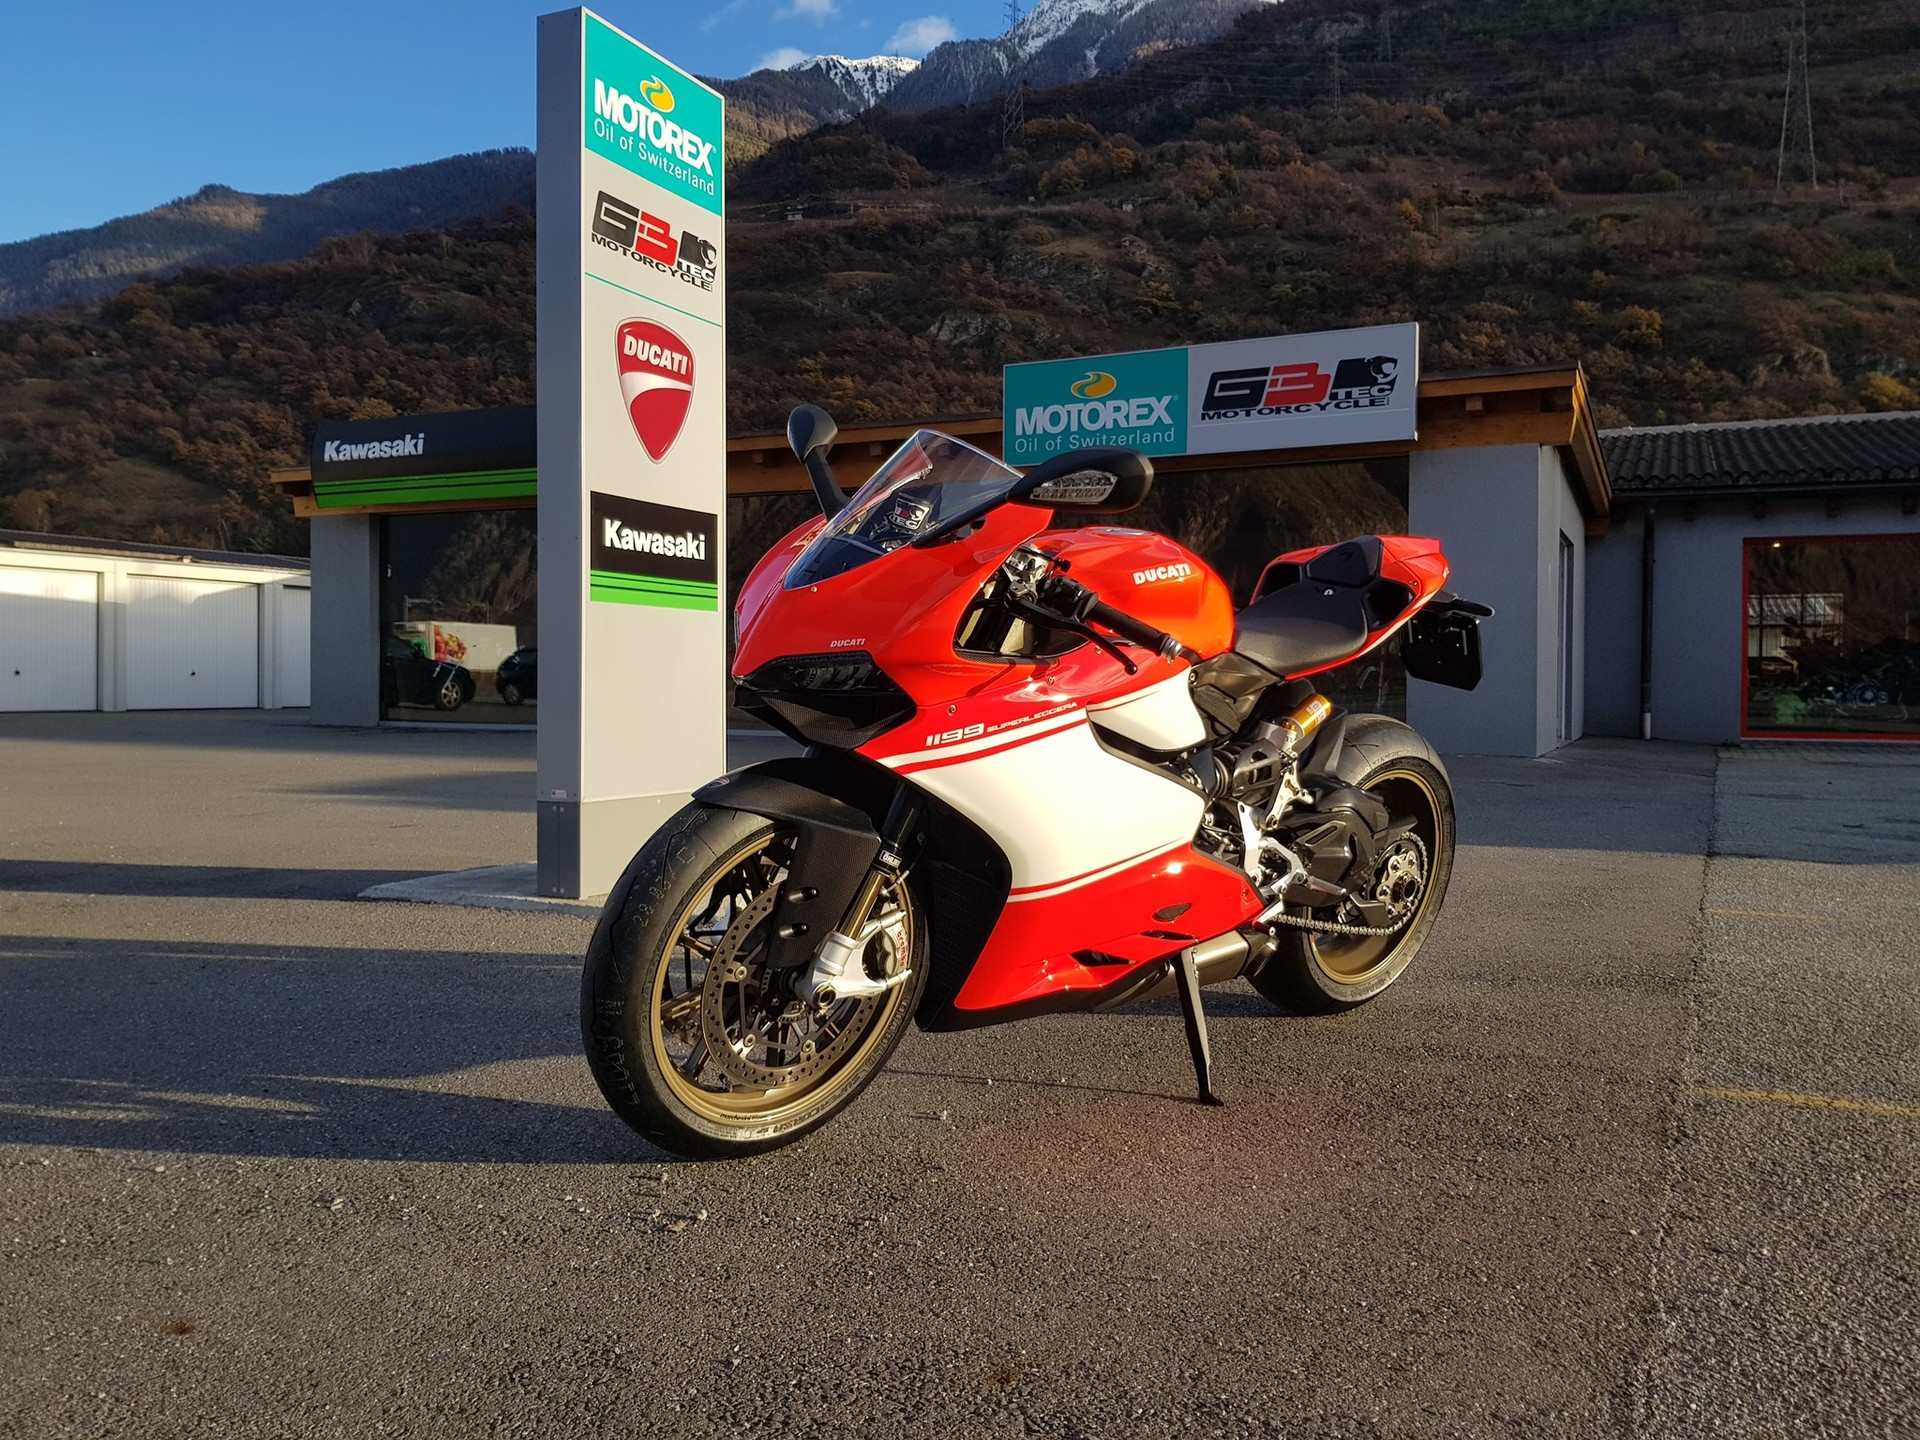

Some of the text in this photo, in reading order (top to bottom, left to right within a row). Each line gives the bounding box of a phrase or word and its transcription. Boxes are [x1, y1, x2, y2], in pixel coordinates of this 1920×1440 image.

[594, 77, 714, 177] MOTOREX
[593, 117, 715, 196] Oil of Switzerland
[591, 231, 712, 293] MOTORCYCLE
[678, 257, 715, 283] TEC
[623, 334, 688, 376] DUCATI
[1201, 396, 1386, 421] MOTORCYCLE
[1331, 385, 1392, 401] TEC
[1015, 396, 1173, 436] MOTOREX
[324, 433, 425, 462] Kawasaki
[1015, 428, 1175, 454] Oil of Switzerland
[604, 518, 706, 561] Kawasaki
[1133, 563, 1191, 585] DUCATI
[830, 638, 866, 648] DUCATI
[925, 701, 1078, 747] 1199 SUPERLEGGERA
